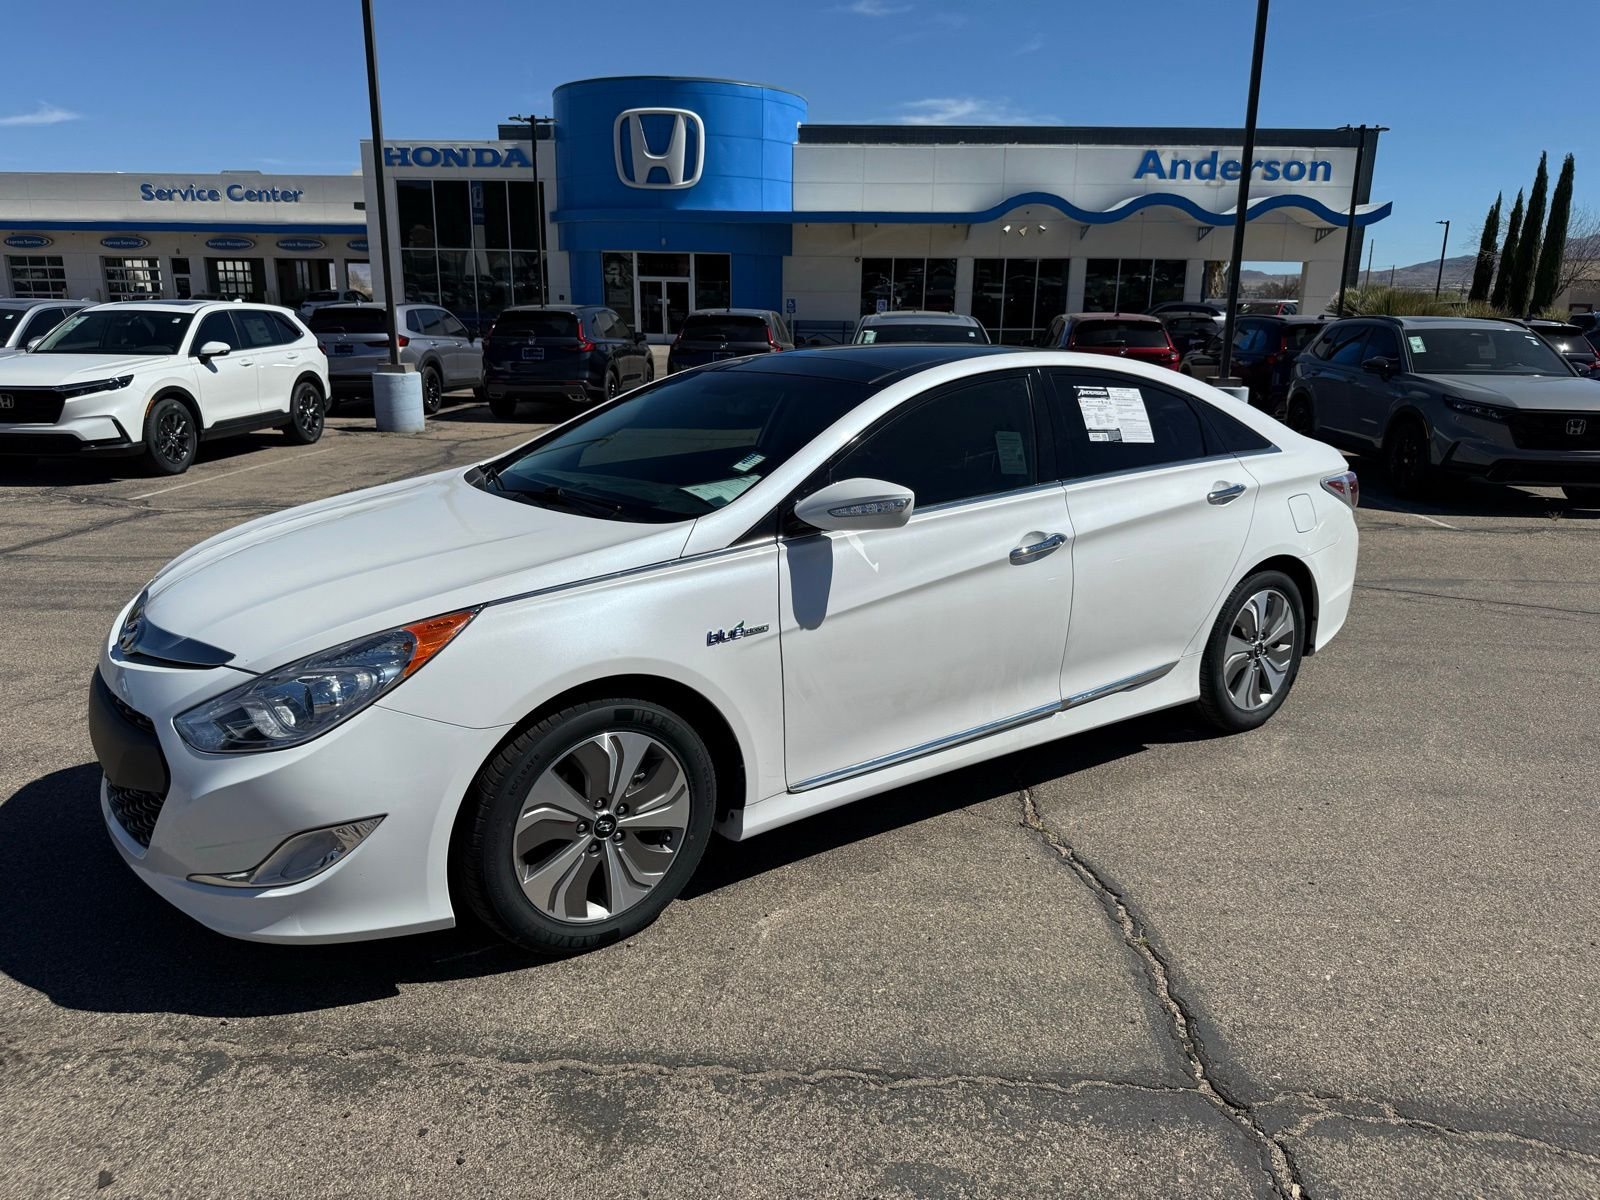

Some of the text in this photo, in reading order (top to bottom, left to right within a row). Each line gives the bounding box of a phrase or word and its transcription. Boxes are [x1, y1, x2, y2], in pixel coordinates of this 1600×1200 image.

[384, 146, 532, 167] HONDA
[141, 183, 304, 203] Service Center
[707, 626, 745, 646] blue
